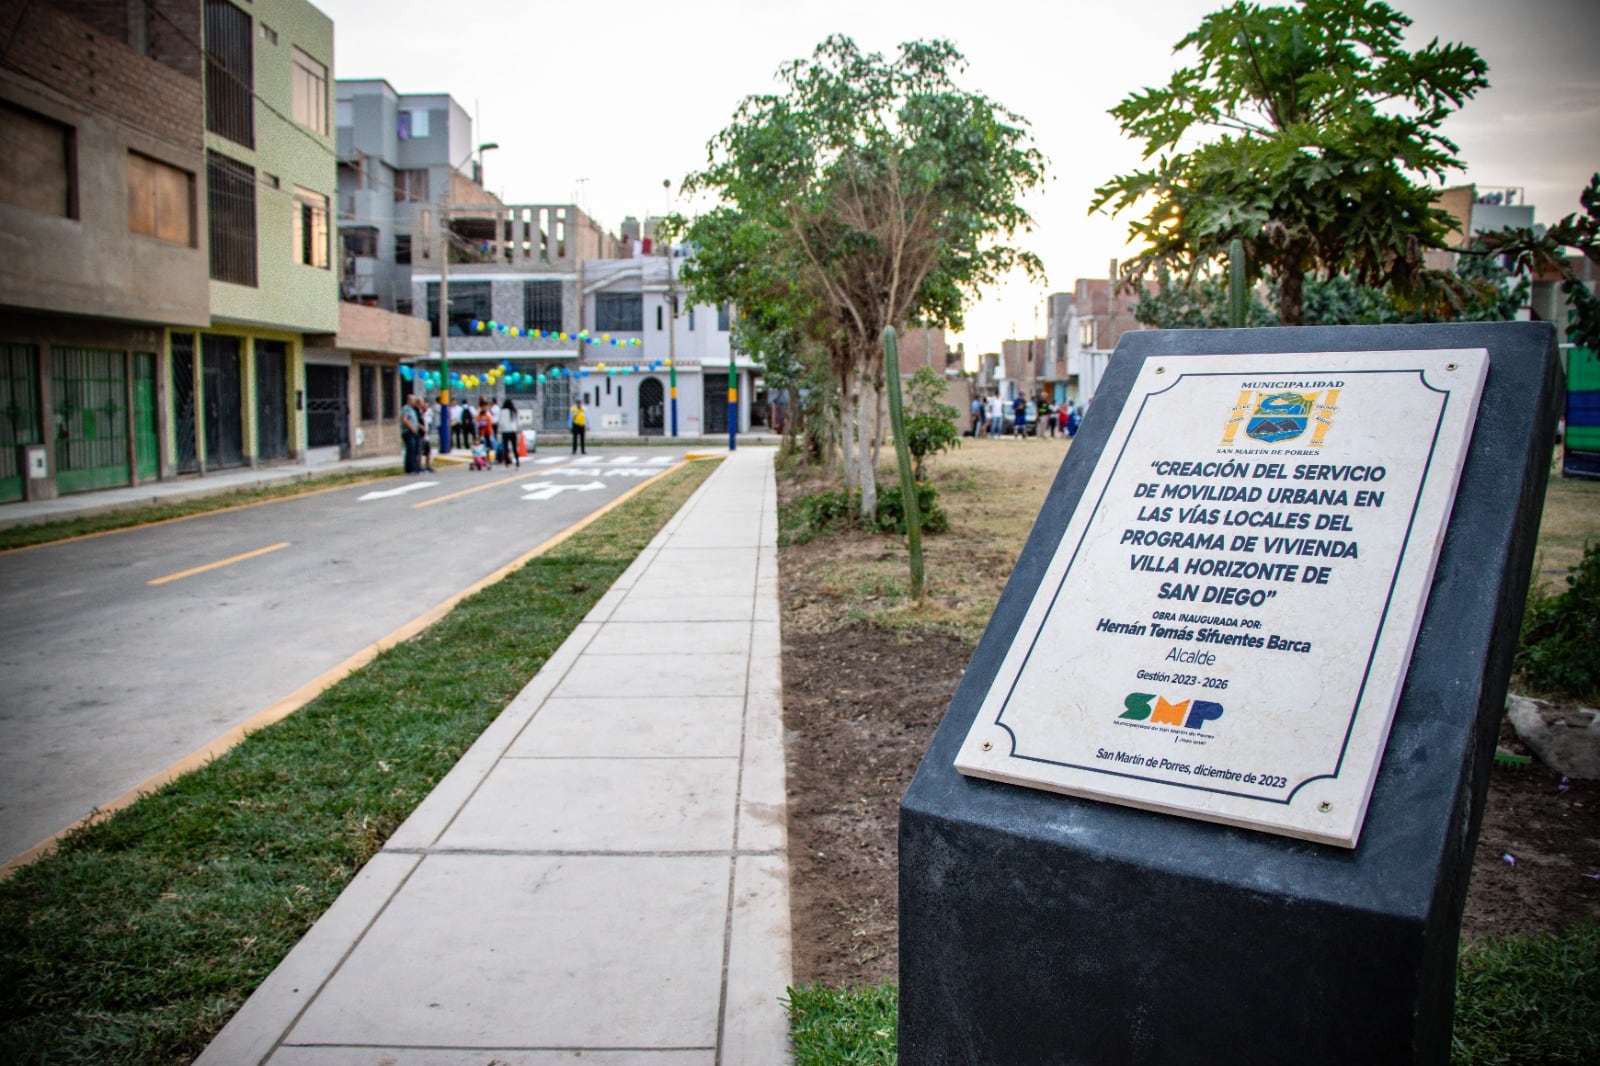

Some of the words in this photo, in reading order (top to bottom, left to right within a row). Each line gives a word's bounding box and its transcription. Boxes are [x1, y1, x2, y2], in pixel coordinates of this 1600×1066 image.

[1241, 381, 1345, 389] MUNICIPALIDAD
[1252, 463, 1288, 480] DEL
[1294, 464, 1386, 482] SERVICIO
[1133, 483, 1160, 498] DE
[1160, 484, 1262, 503] MOVILIDAD
[1267, 488, 1348, 506] URBANA
[1354, 490, 1385, 507] EN
[1136, 506, 1172, 522] LAS
[1178, 504, 1220, 525] VÍAS
[1223, 509, 1310, 530] LOCALES
[1315, 515, 1353, 532] DEL
[1120, 529, 1224, 550] PROGRAMA
[1229, 535, 1258, 552] DE
[1264, 537, 1359, 559] VIVIENDA
[1130, 554, 1179, 573] VILLA
[1184, 558, 1299, 582] HORIZONTE
[1301, 567, 1331, 584] DE
[1157, 583, 1200, 601] SAN
[1152, 611, 1176, 622] OBRA
[1178, 613, 1238, 628] INAUGURADA
[1240, 618, 1262, 629] POR:
[1096, 618, 1146, 636] Hernán
[1149, 623, 1194, 641] Tomás
[1196, 628, 1264, 648] Sifuentes
[1266, 635, 1311, 653] Barca
[1165, 647, 1216, 666] Alcalde
[1136, 669, 1170, 683] Gestión
[1118, 692, 1224, 730] SMP
[1096, 748, 1114, 761] San
[1114, 750, 1144, 767] Martín
[1145, 756, 1158, 768] de
[1159, 759, 1192, 775] Porres,
[1193, 764, 1242, 783] diciembre
[1243, 772, 1256, 785] de
[1257, 774, 1287, 789] 2023
